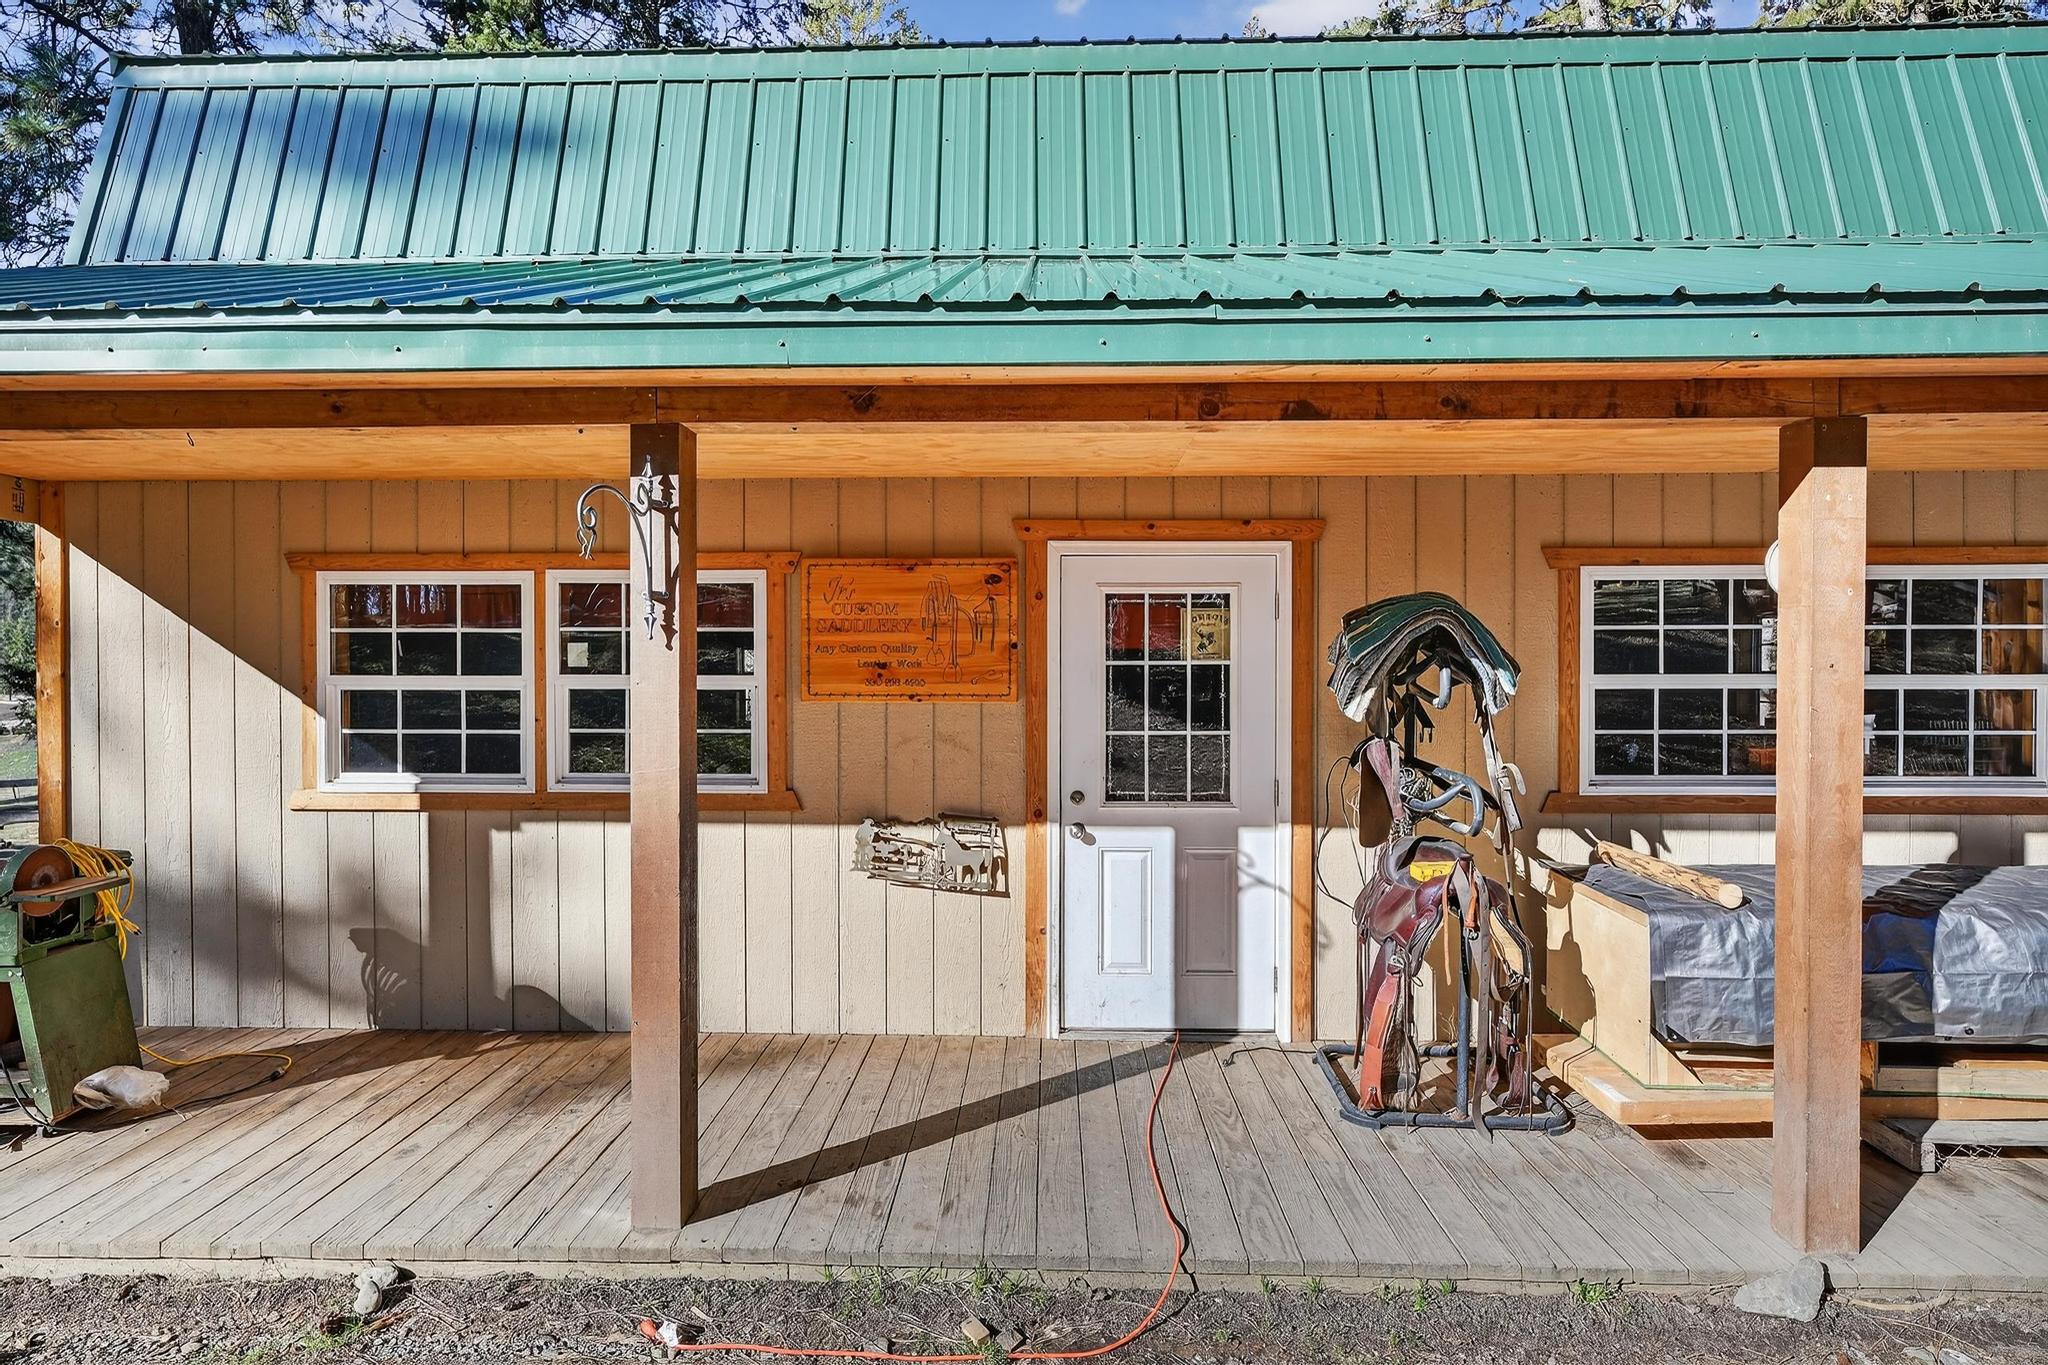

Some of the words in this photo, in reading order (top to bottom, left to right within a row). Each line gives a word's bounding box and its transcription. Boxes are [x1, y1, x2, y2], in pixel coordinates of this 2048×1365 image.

[831, 602, 900, 616] CUSTOM
[816, 618, 913, 633] SADDLERY
[815, 644, 836, 656] Any
[839, 643, 877, 654] Custom
[880, 643, 918, 656] Quality
[896, 658, 923, 669] Work
